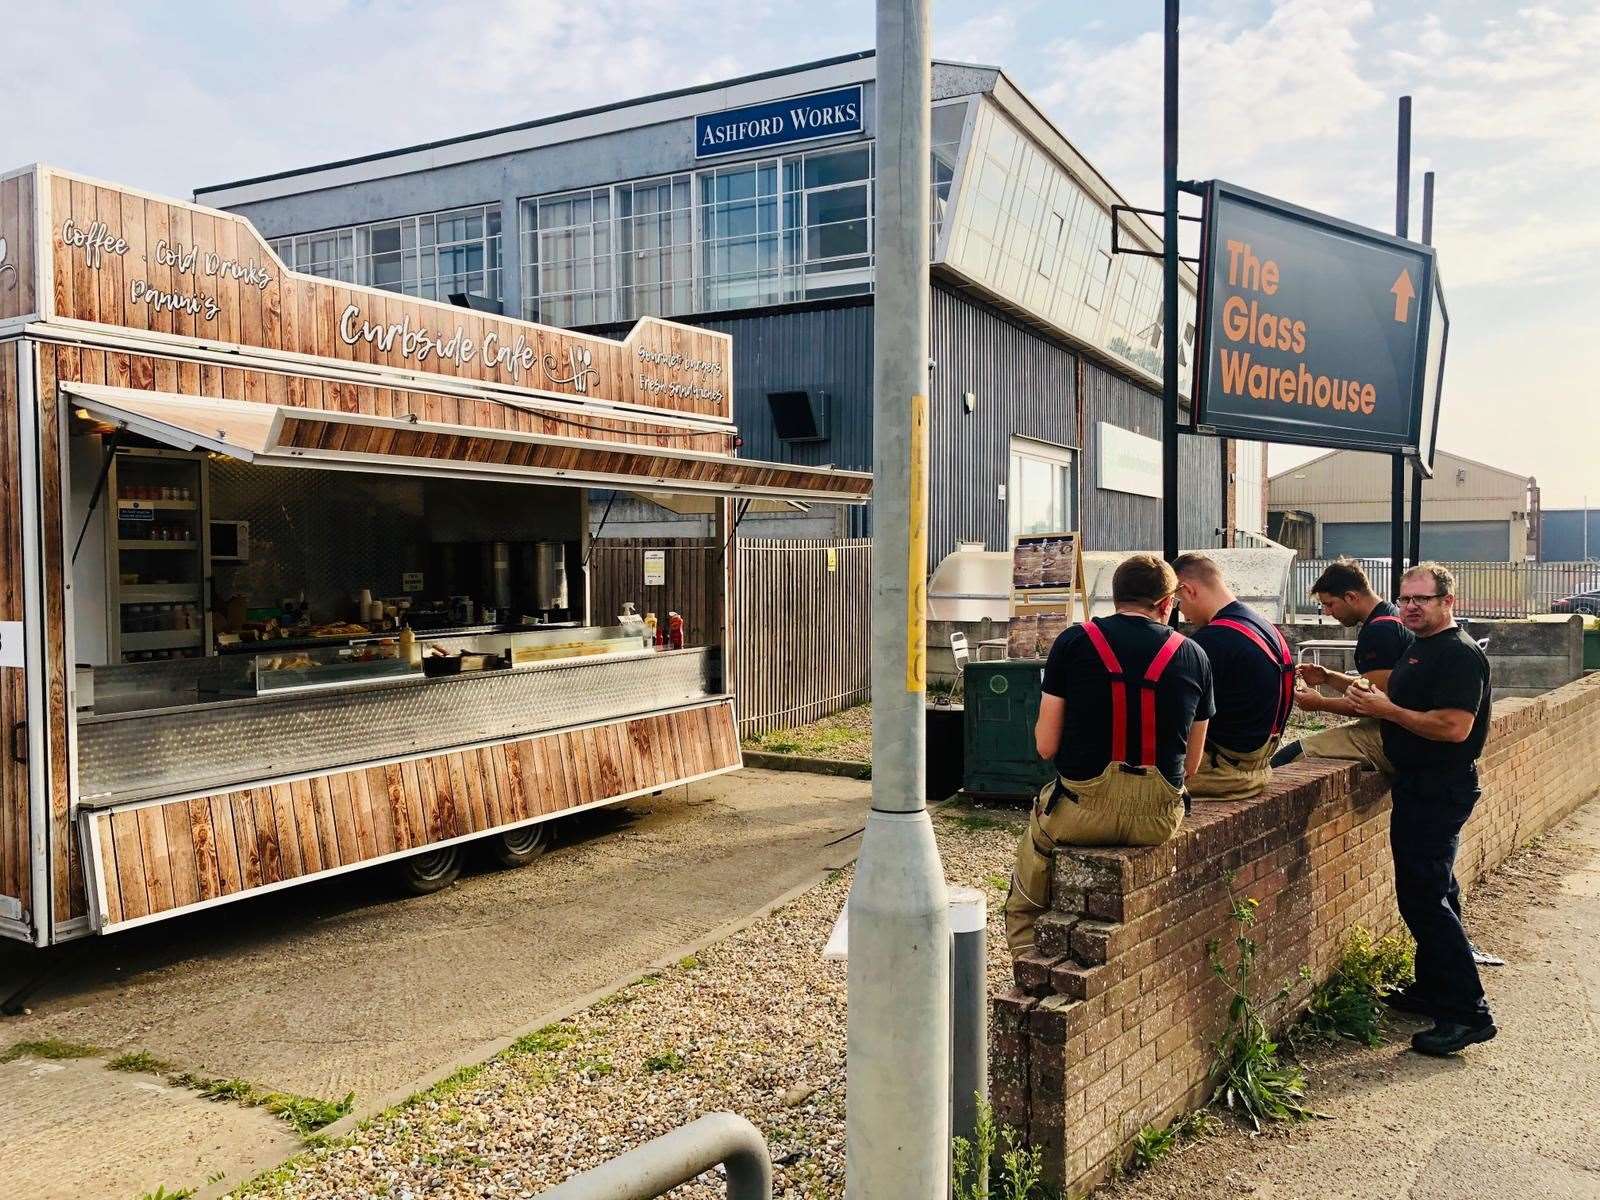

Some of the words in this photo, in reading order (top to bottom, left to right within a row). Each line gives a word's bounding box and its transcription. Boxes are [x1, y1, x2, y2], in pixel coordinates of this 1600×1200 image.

[703, 116, 783, 146] ASHFORD
[790, 103, 856, 131] WORKS
[62, 218, 129, 269] Coffee
[157, 239, 199, 275] Cold
[205, 252, 273, 290] Drinks
[1226, 239, 1280, 295] The
[340, 304, 477, 367] Curbside
[482, 332, 537, 381] Cafe
[1222, 296, 1306, 353] Glass
[1220, 349, 1376, 415] Warehouse
